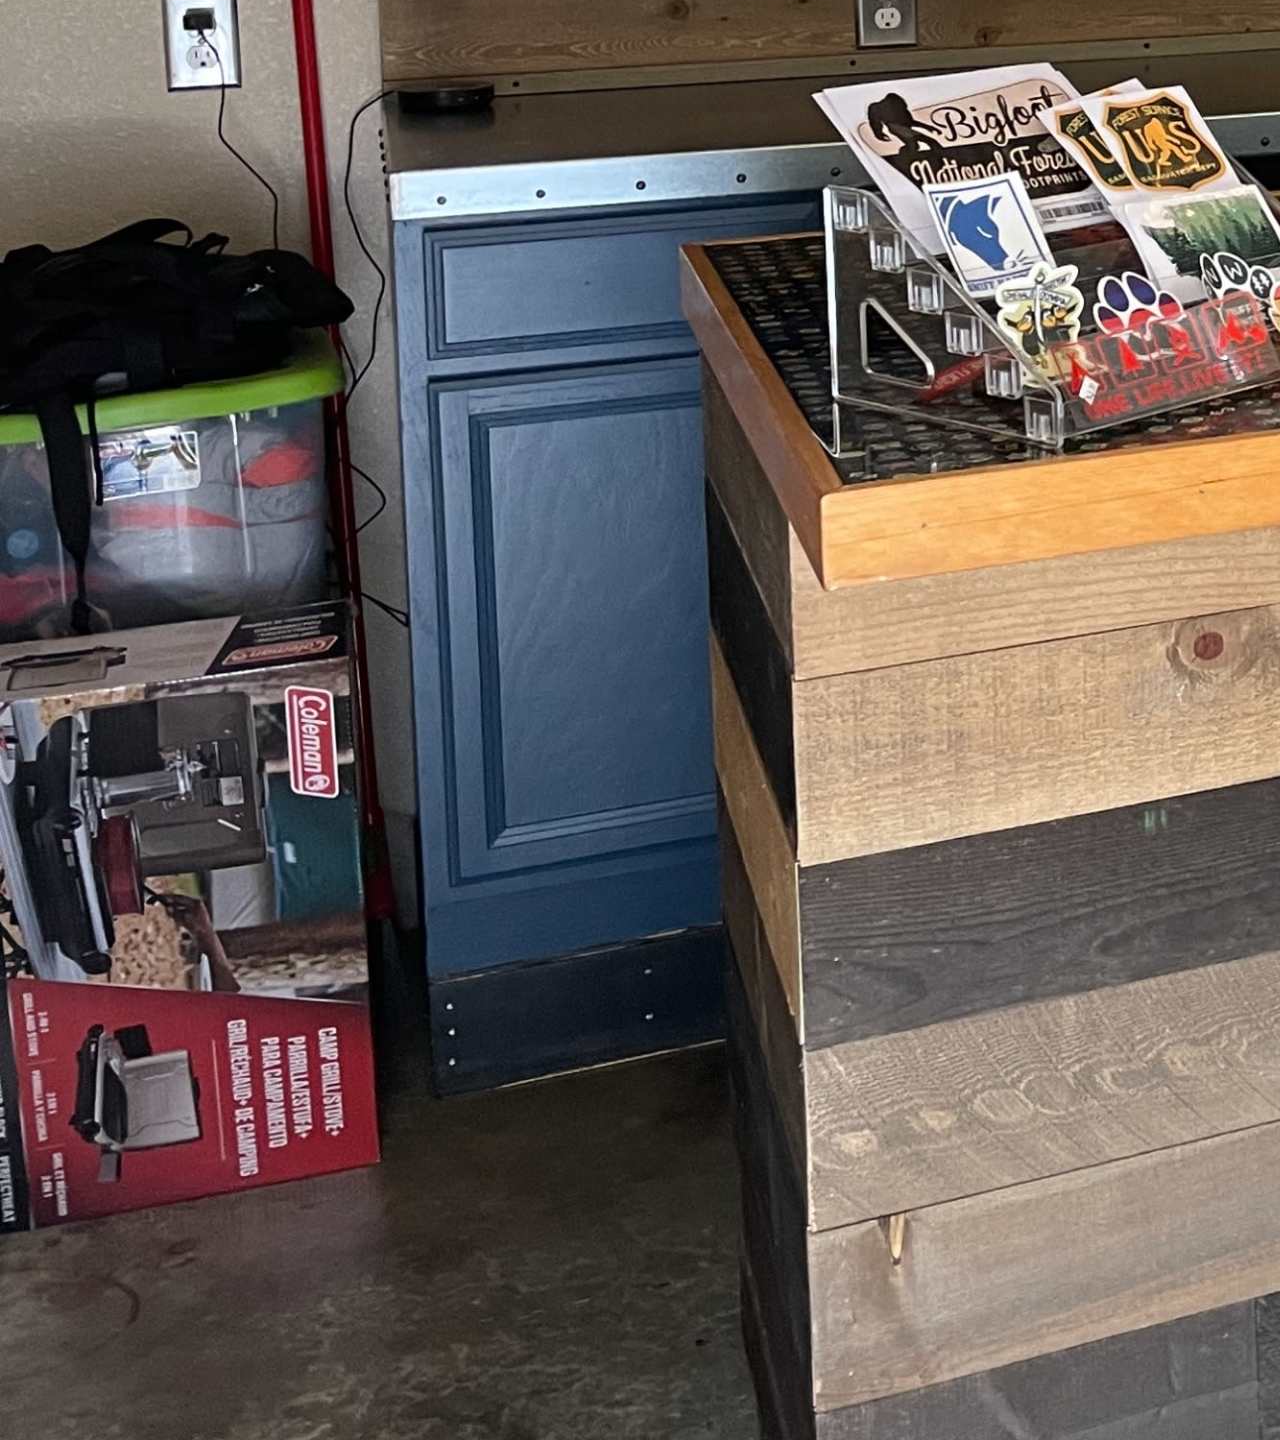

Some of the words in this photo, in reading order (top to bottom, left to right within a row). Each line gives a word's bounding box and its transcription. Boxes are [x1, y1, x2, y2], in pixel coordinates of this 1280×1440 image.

[930, 85, 1063, 146] Bigfoot
[1112, 109, 1139, 130] FOREST
[910, 150, 1004, 187] National
[299, 695, 329, 773] Coleman
[261, 1037, 281, 1068] PARA
[318, 1027, 339, 1060] CAMP
[235, 1107, 254, 1124] DE
[263, 1068, 288, 1149] CAMPAMENTO
[236, 1123, 259, 1177] CAMPING
